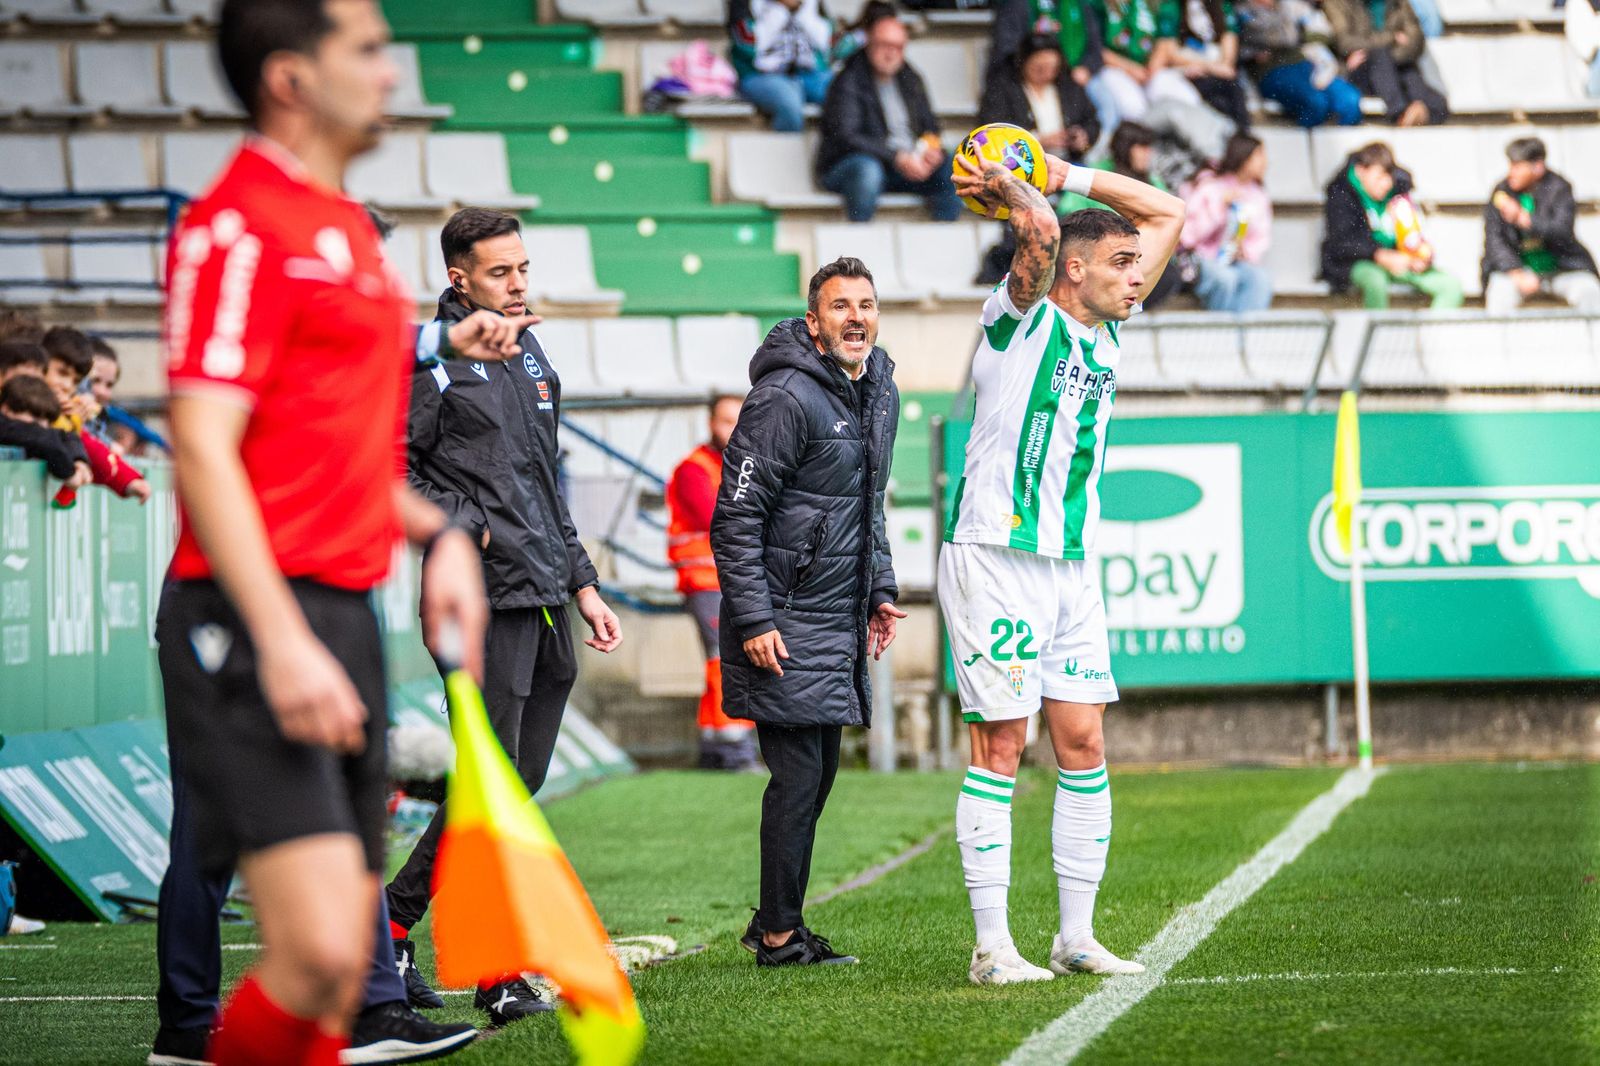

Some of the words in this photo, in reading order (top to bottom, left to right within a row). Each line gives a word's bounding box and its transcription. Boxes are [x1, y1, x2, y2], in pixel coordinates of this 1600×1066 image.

[1030, 412, 1049, 469] HUMANIDAD
[1100, 553, 1217, 615] pay
[991, 618, 1038, 661] 22
[1108, 625, 1245, 656] ILIARIO
